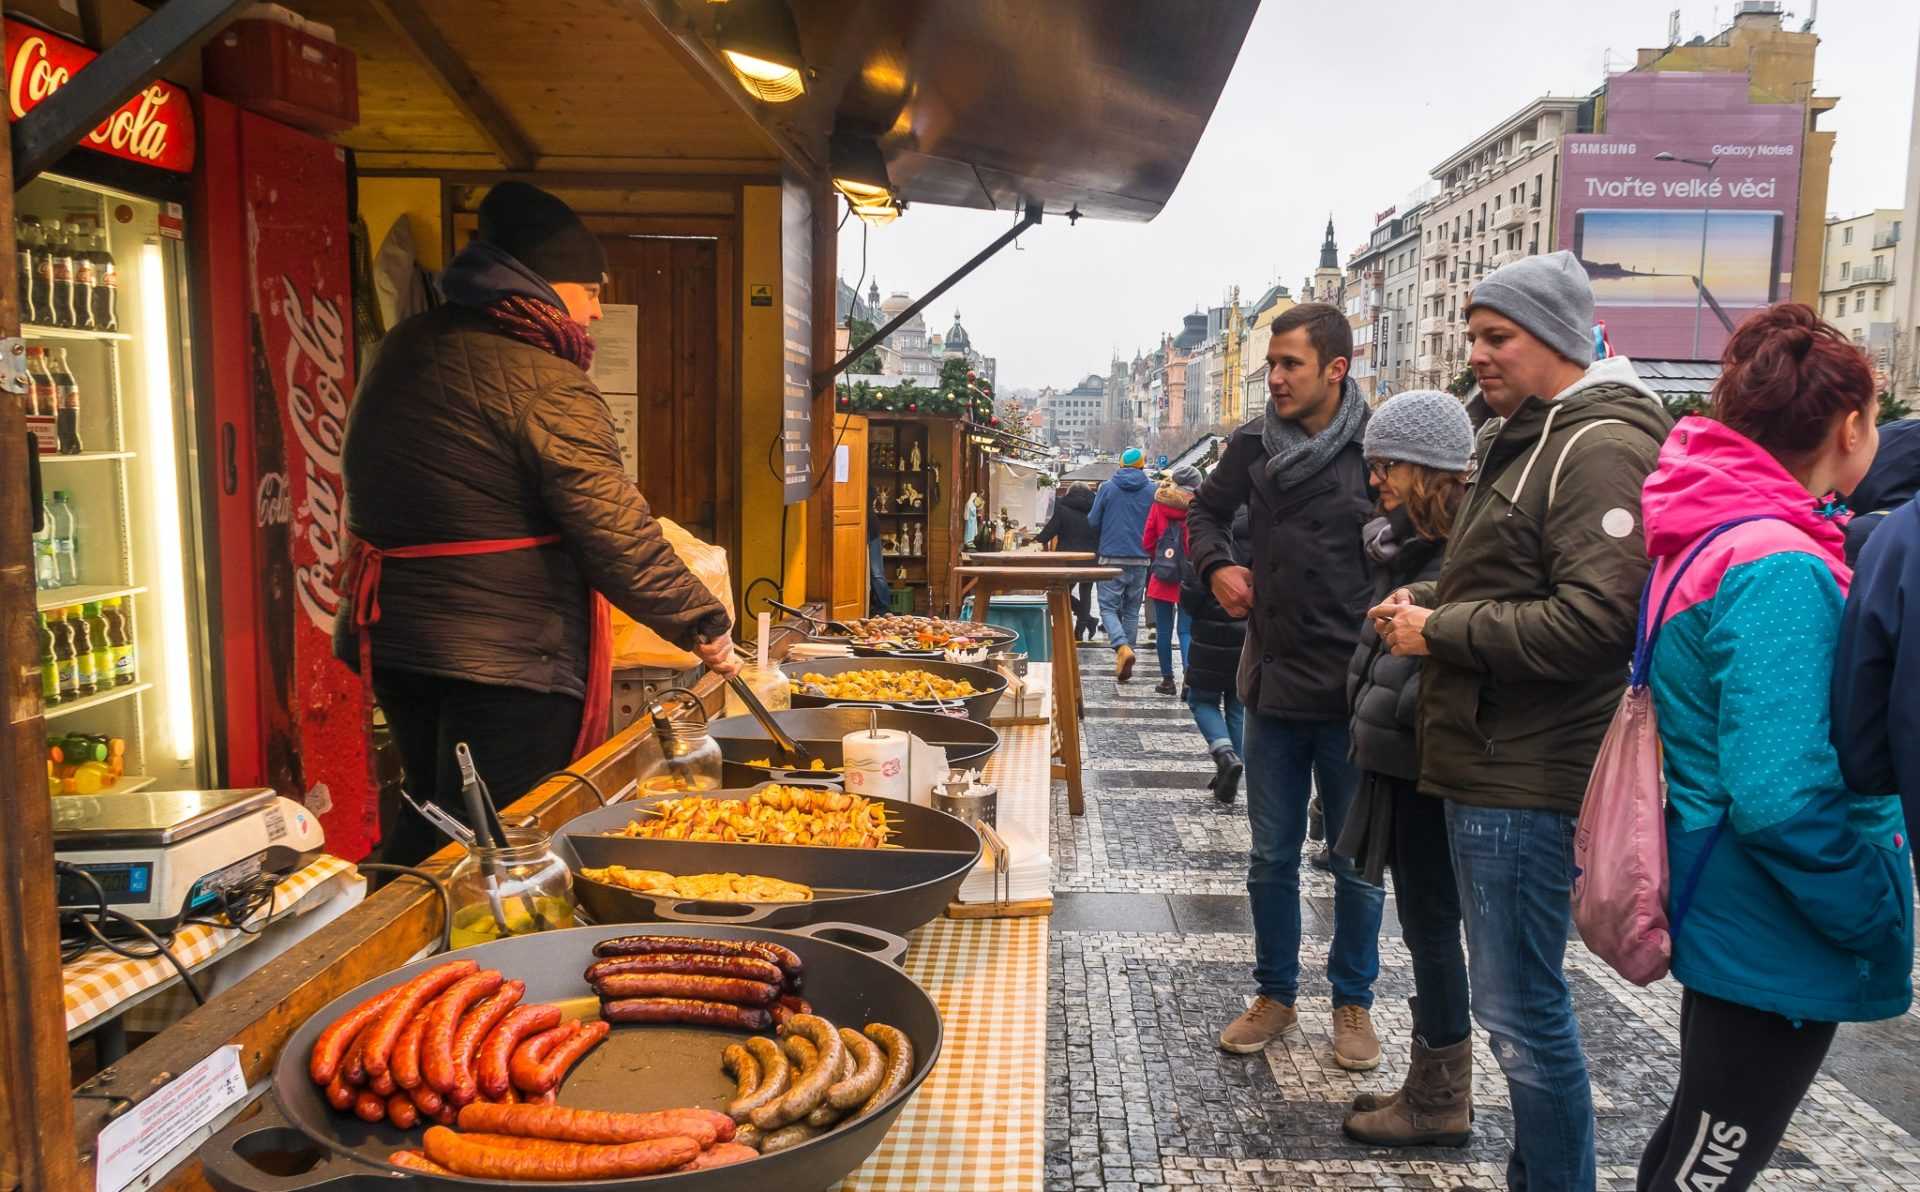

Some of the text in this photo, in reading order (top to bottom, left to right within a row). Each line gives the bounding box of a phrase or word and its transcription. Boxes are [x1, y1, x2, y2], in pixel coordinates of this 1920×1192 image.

[1570, 143, 1637, 154] SAMSUNG
[1711, 144, 1794, 158] Galaxy Note8
[1584, 176, 1776, 198] Tvořte velké věci
